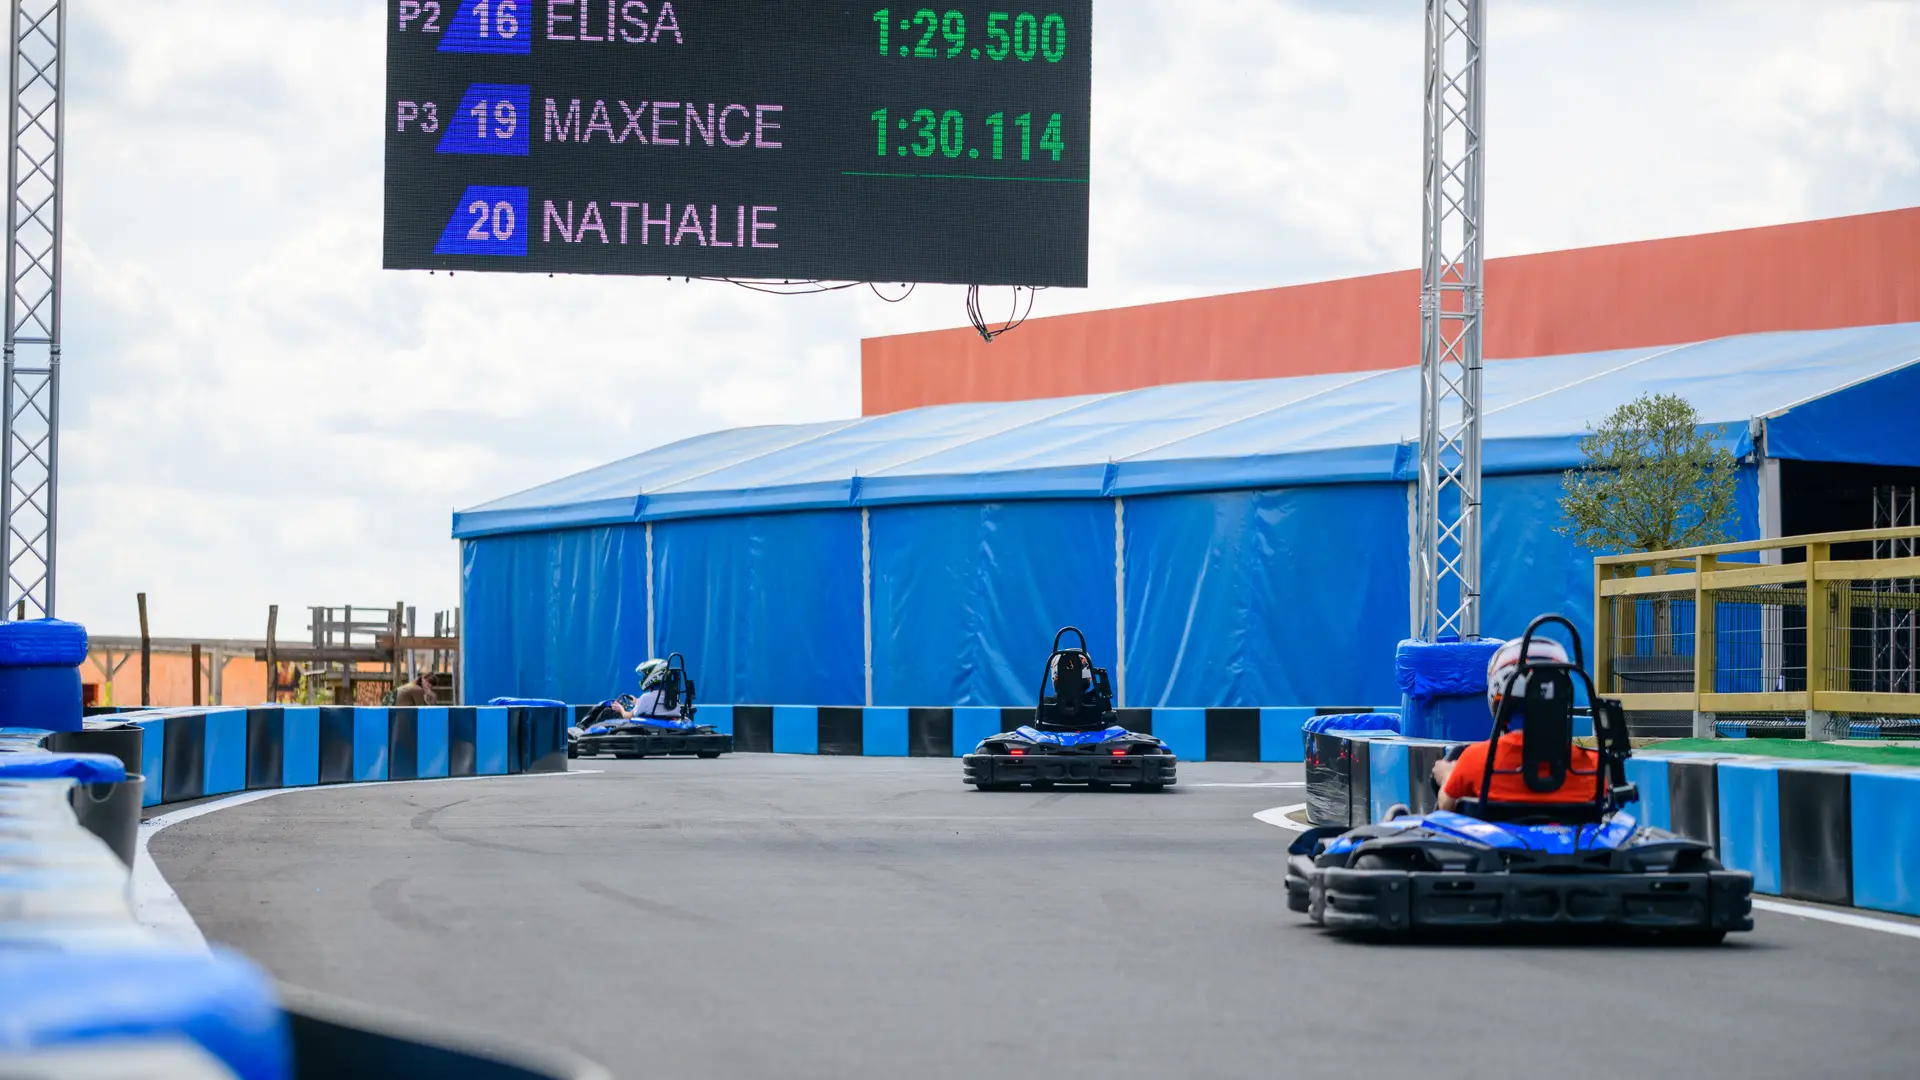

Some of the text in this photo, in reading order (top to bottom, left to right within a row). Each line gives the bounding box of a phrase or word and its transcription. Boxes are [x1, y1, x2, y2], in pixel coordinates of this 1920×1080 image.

[399, 0, 1066, 63] P2 16 ELISA 1:29.500
[397, 98, 1065, 161] P3 19 MAXENCE 1:30.114
[467, 200, 779, 249] 20 NATHALIE
